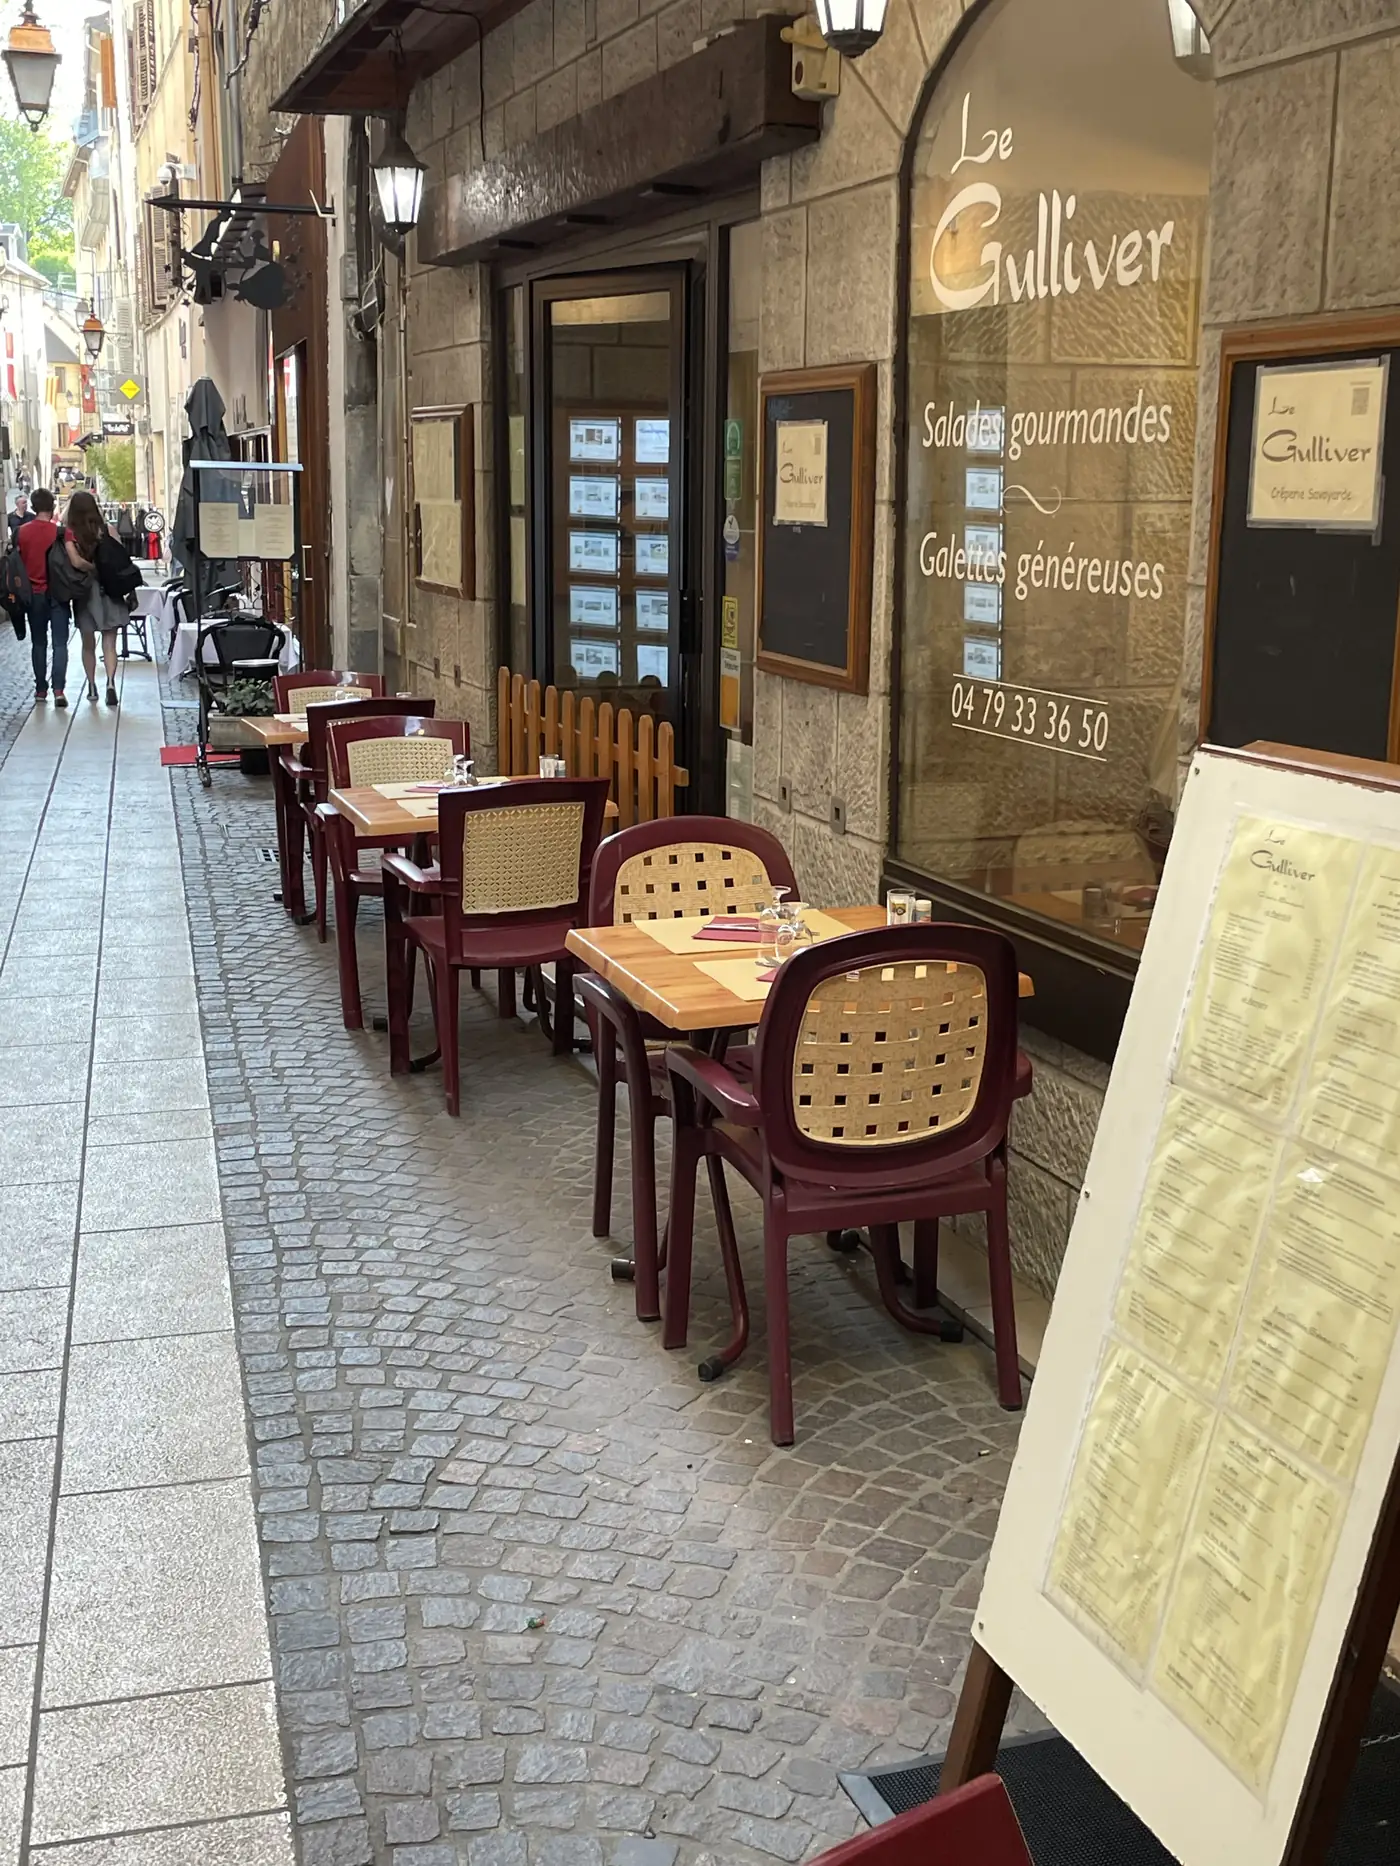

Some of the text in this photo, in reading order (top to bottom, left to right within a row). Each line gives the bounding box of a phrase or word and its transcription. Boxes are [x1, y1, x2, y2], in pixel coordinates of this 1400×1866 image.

[951, 92, 1013, 175] Le
[930, 181, 1175, 311] Gulliver
[922, 388, 1173, 461] Salades gourmandes
[1268, 396, 1296, 416] Le
[780, 462, 823, 485] Gulliver
[1262, 428, 1372, 464] Gulliver
[919, 531, 1166, 601] Galettes généreuses
[951, 682, 1109, 751] 04 79 33 36 50
[1250, 849, 1316, 881] Gulliver
